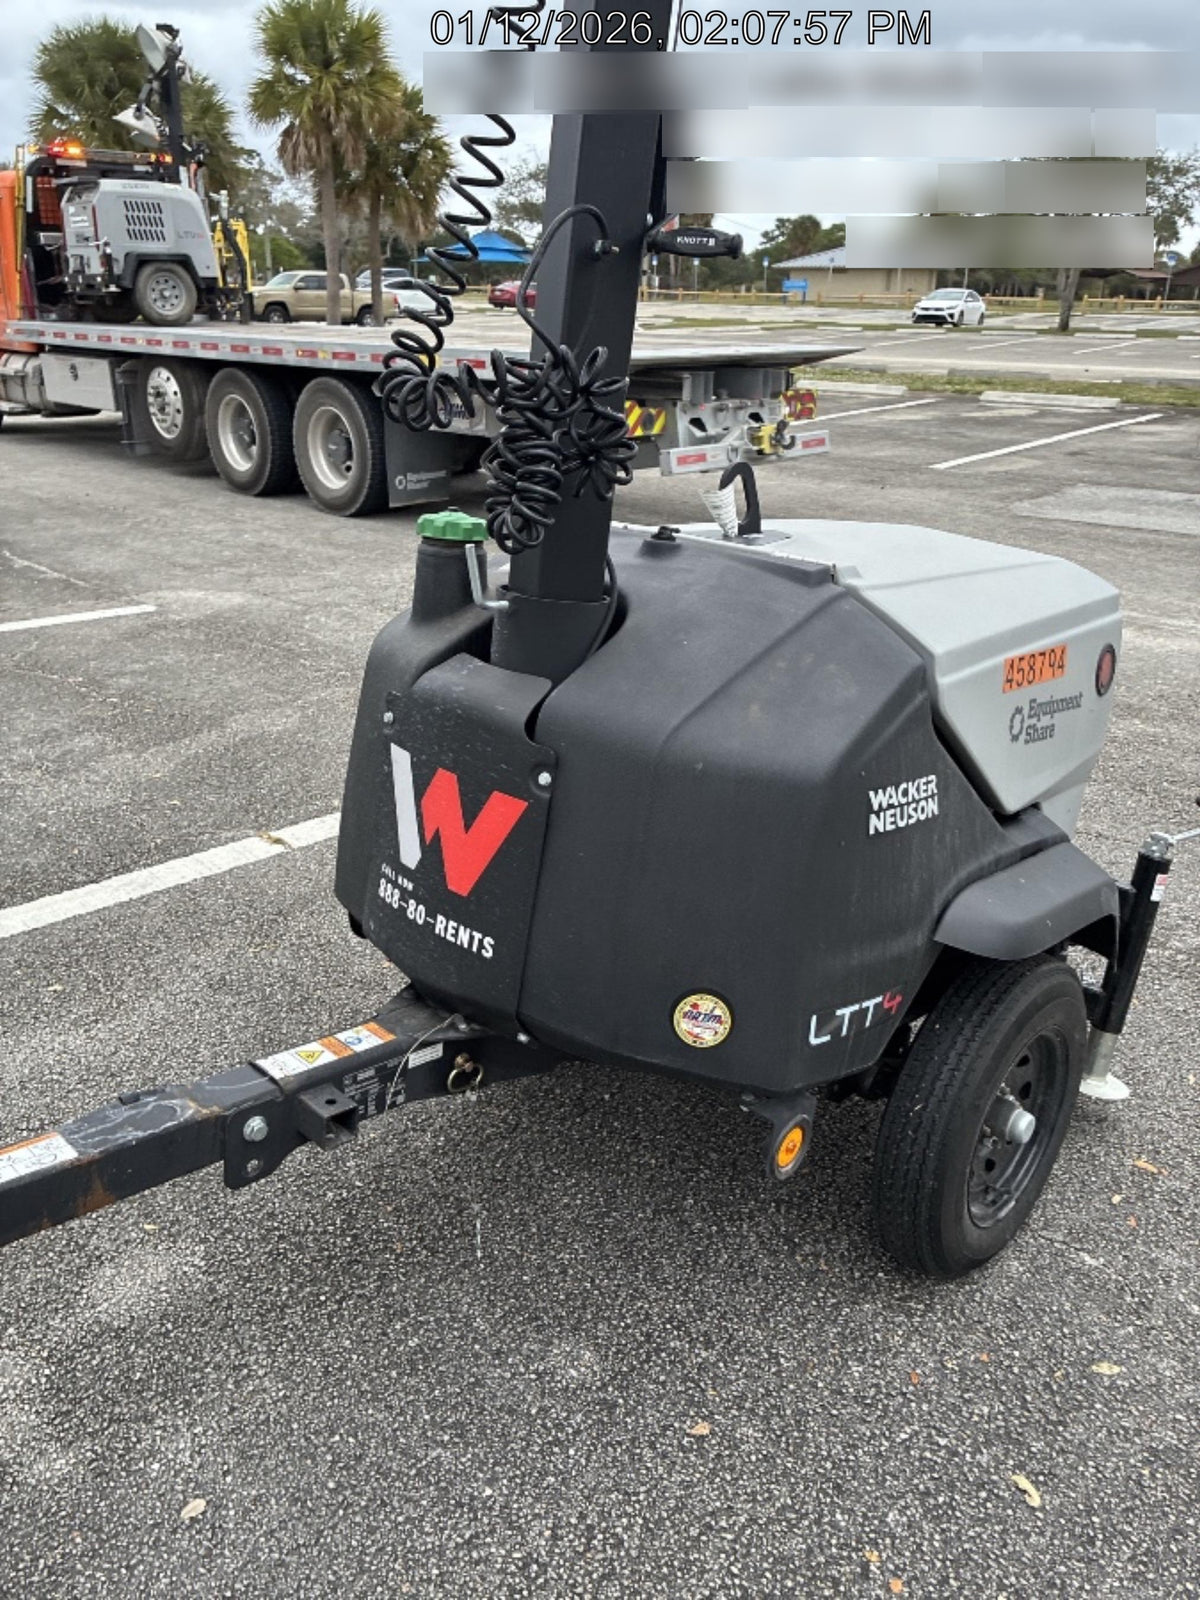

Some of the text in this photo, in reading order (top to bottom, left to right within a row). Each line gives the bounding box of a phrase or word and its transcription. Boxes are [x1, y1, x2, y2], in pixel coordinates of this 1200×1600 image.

[676, 235, 708, 246] KNOTT
[1005, 647, 1067, 689] 458794
[1028, 691, 1083, 722] Equipment
[1023, 723, 1055, 745] Share
[868, 774, 938, 811] WACKER
[868, 795, 939, 836] NEUSON
[378, 877, 495, 959] 888-80-RENTS
